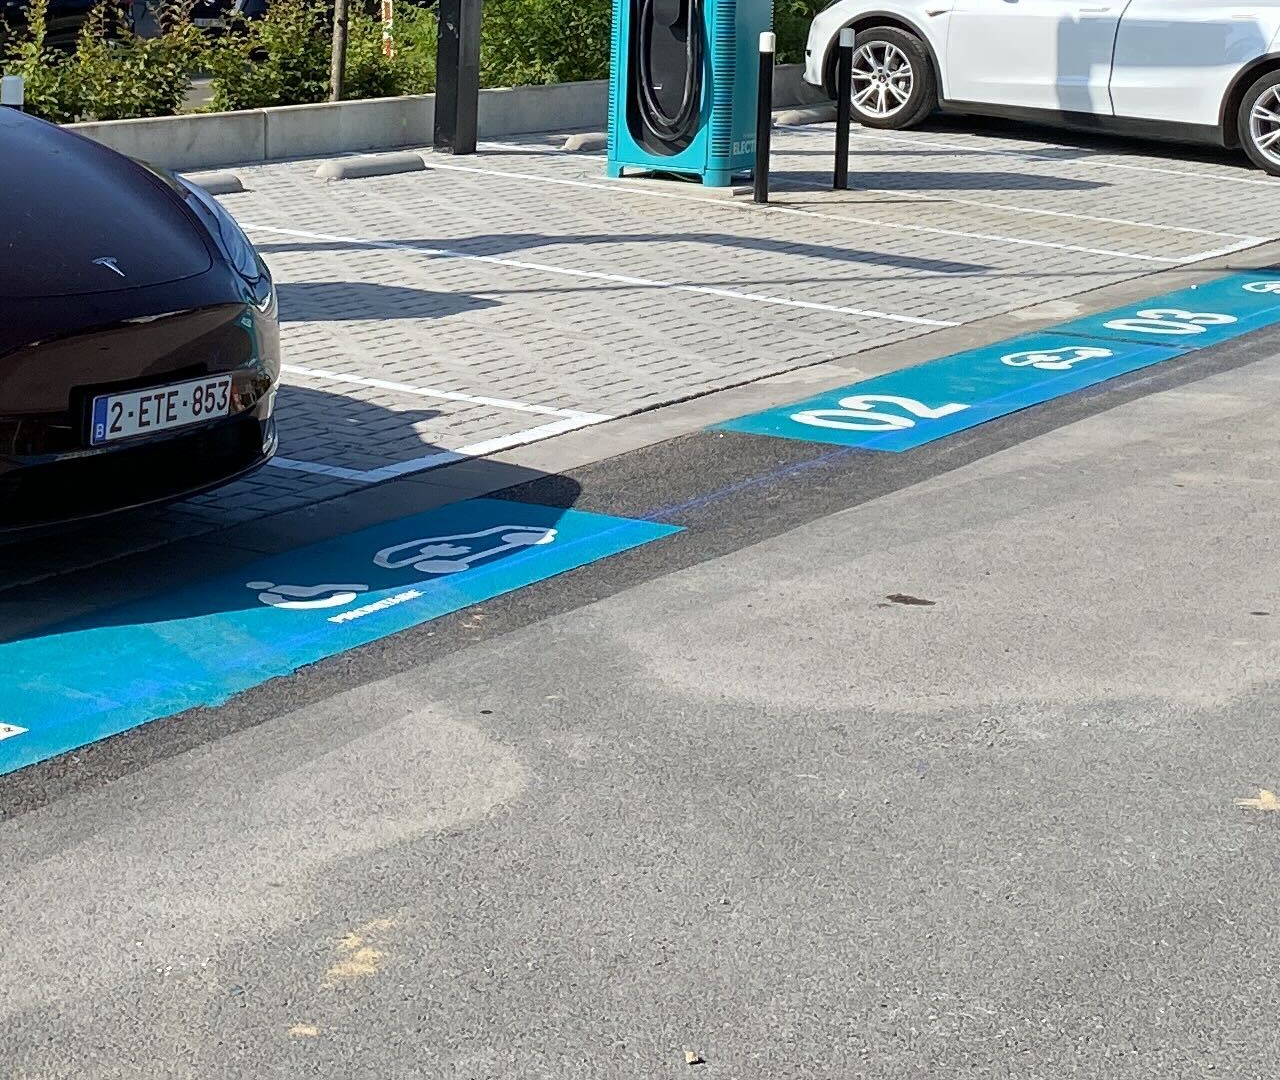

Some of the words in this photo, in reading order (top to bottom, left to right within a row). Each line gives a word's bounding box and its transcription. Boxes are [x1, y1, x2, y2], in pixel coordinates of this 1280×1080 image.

[1102, 307, 1239, 335] 03
[789, 394, 971, 432] 02
[95, 423, 105, 439] B
